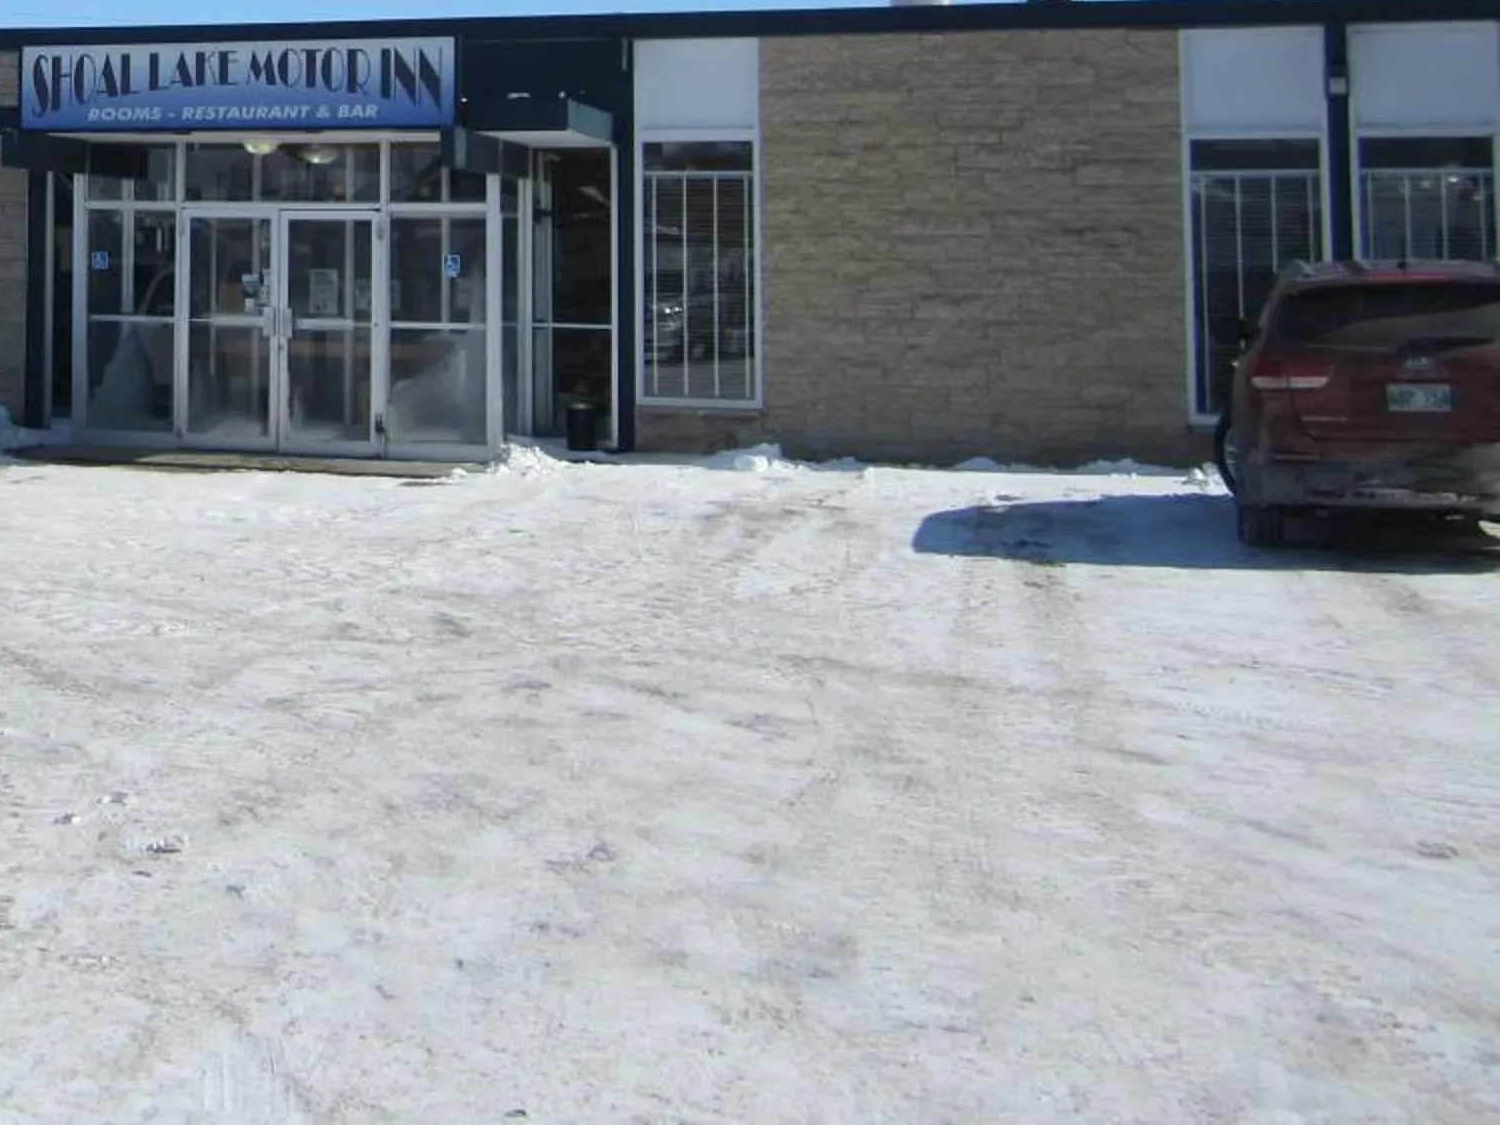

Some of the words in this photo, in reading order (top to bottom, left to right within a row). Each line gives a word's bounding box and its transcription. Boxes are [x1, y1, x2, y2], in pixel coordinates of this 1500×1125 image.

[32, 52, 139, 117] SHOAL
[150, 51, 239, 91] LAKE
[246, 46, 371, 95] MOTOR
[381, 46, 442, 115] INN
[88, 107, 161, 122] ROOMS
[181, 105, 311, 121] RESTAURANT
[316, 105, 330, 119] &
[338, 104, 379, 119] BAR
